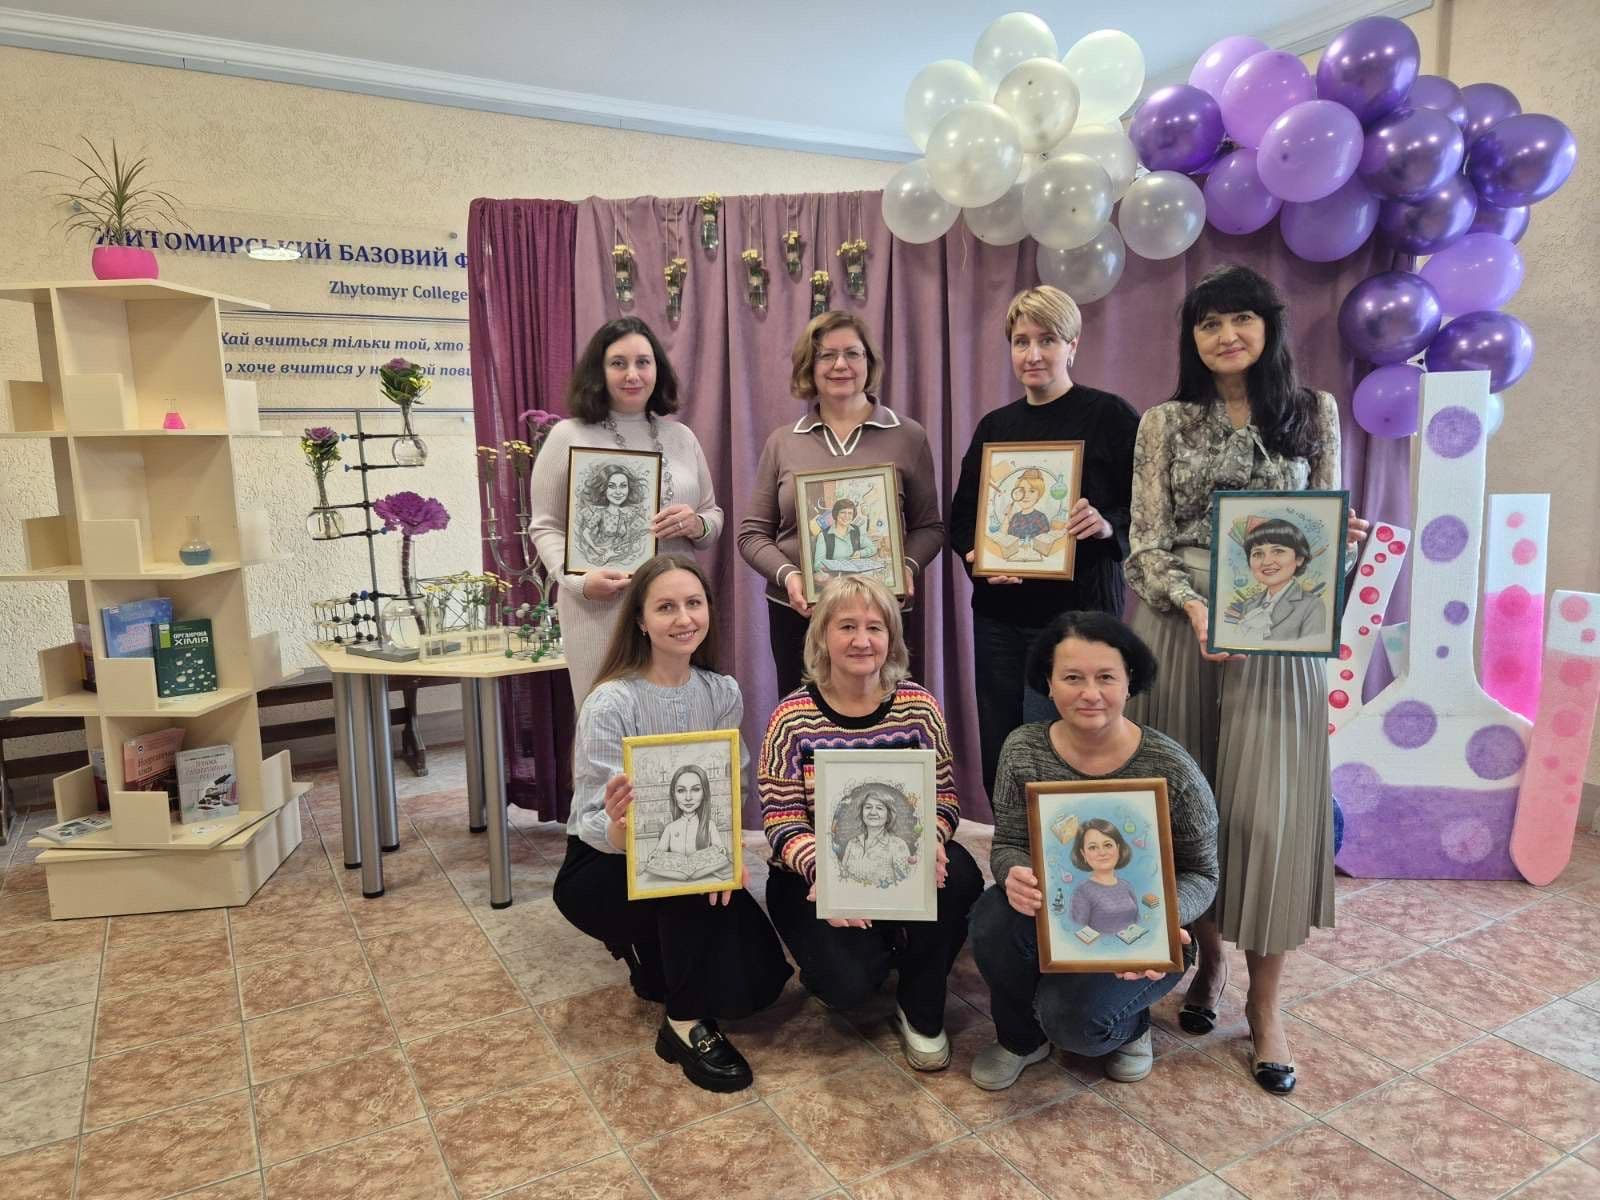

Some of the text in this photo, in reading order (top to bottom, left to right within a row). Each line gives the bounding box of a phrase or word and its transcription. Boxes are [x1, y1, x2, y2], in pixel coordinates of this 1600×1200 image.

[339, 243, 448, 267] БАЗОВИЙ
[329, 281, 468, 303] Zhytomyr College
[255, 335, 328, 348] вчиться
[333, 336, 390, 349] тільки
[395, 338, 431, 351] той,
[434, 341, 464, 351] хто
[238, 363, 276, 374] хоче
[280, 363, 353, 375] вчитися
[356, 364, 366, 377] у
[174, 636, 209, 646] ХІМІЯ
